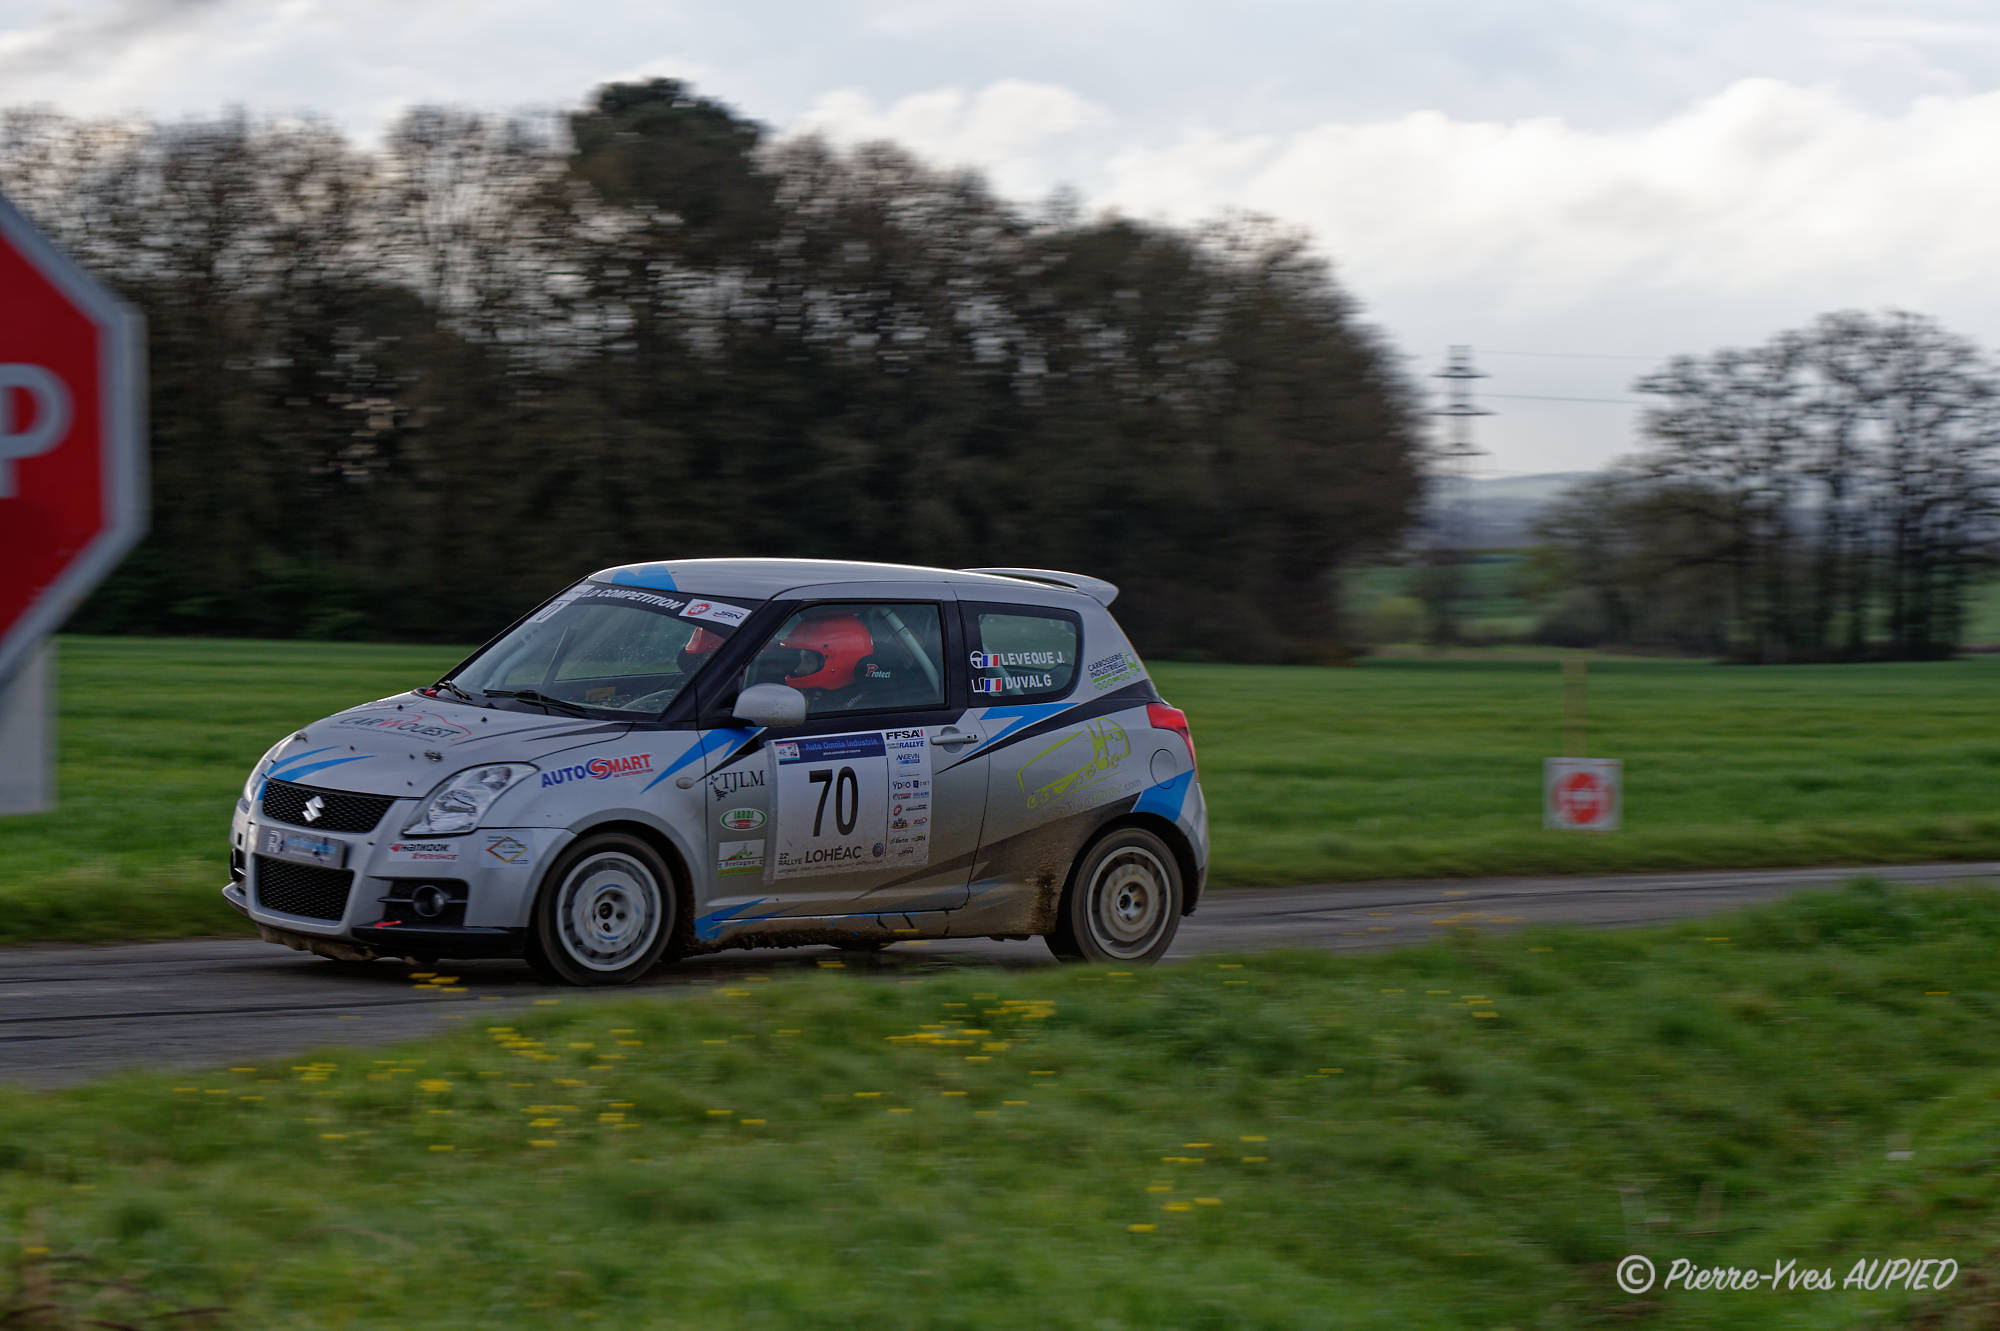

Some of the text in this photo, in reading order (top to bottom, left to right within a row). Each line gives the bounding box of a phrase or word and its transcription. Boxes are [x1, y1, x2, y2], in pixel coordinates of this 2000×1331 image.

[599, 589, 685, 610] COMPETITION
[1000, 651, 1065, 666] LEVEQUE J.
[885, 729, 921, 740] FFSA
[899, 740, 925, 749] RALLYE
[719, 769, 765, 793] TJLM
[808, 766, 859, 837] 70
[804, 845, 862, 864] LOHÉAC
